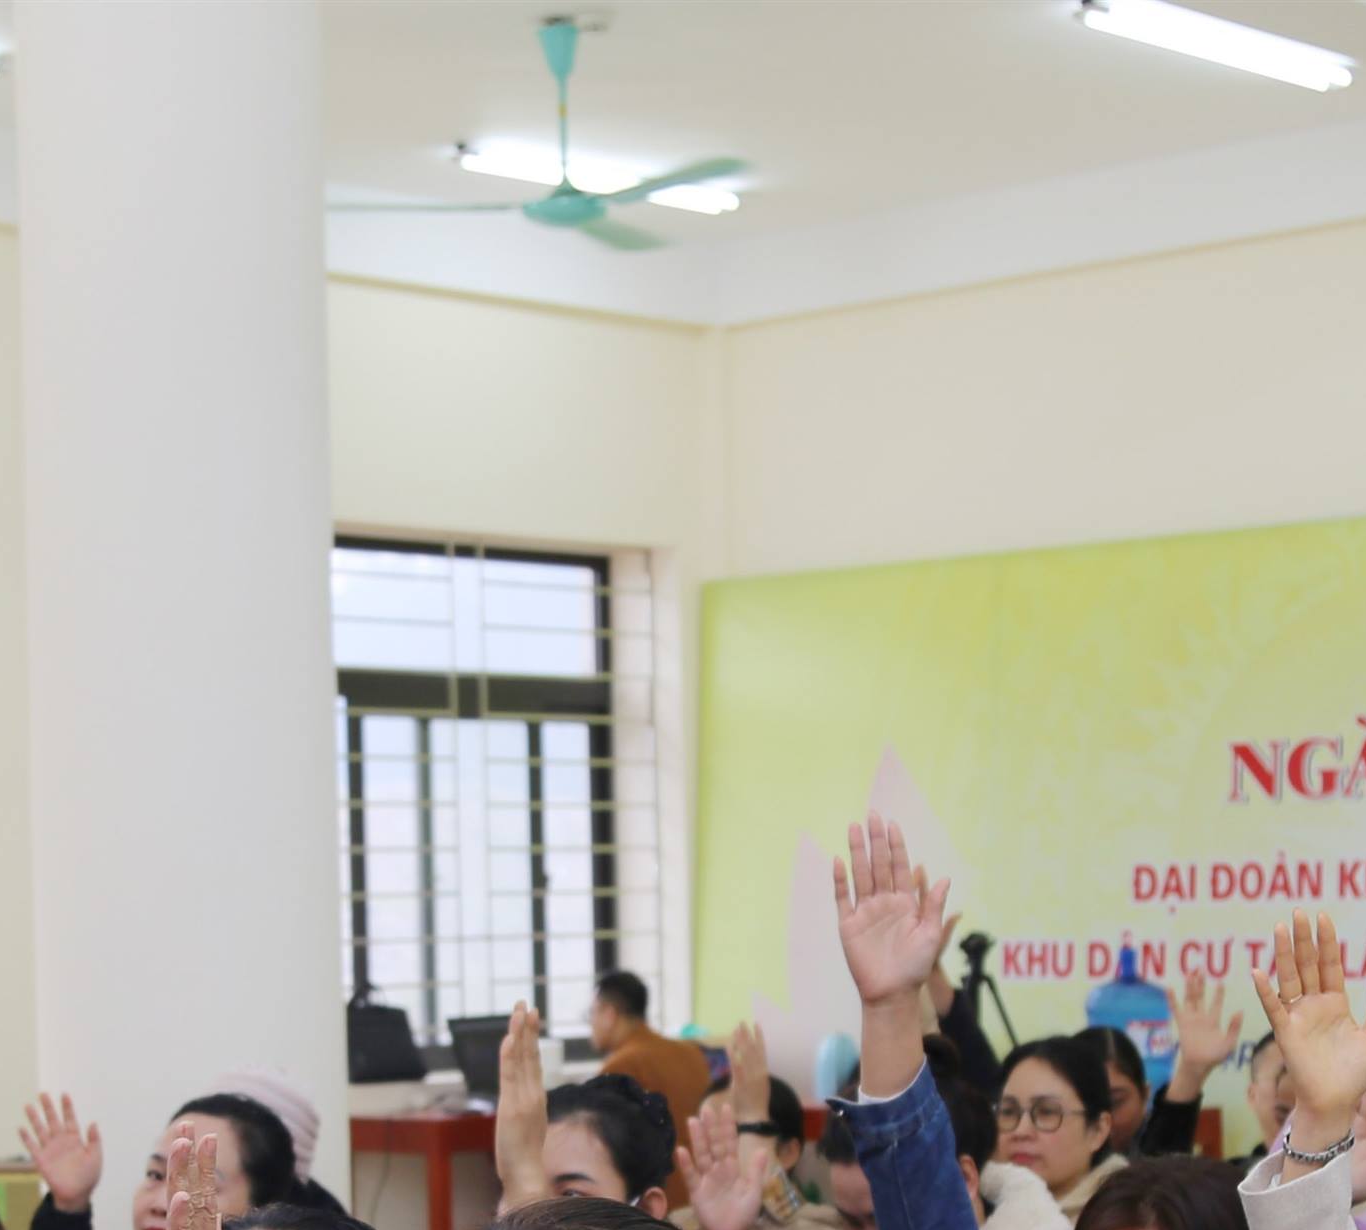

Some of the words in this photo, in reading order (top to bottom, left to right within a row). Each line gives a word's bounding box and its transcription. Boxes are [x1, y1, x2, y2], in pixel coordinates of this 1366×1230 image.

[1133, 864, 1197, 914] ĐẠI
[1210, 852, 1324, 899] ĐOÀN
[1002, 941, 1075, 979] KHU
[1087, 929, 1167, 981] DN
[1178, 936, 1235, 979] CƯ
